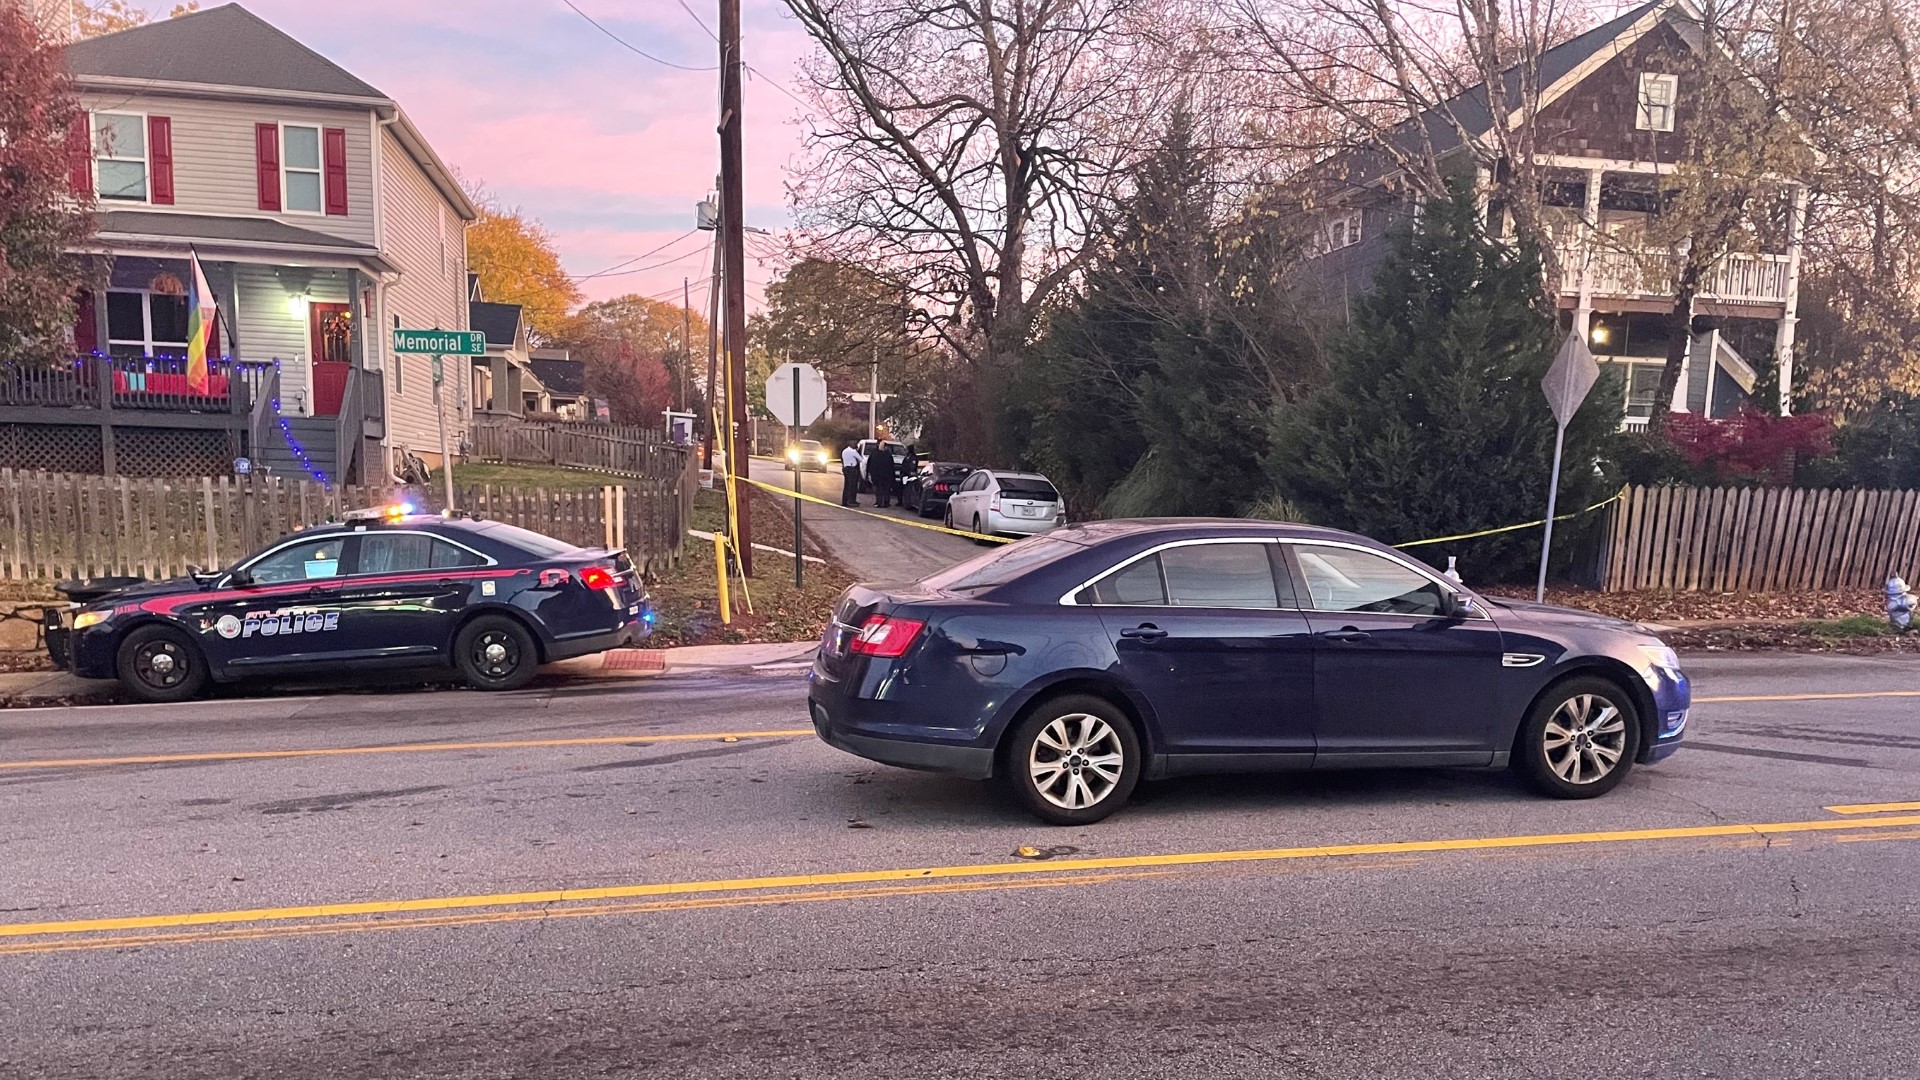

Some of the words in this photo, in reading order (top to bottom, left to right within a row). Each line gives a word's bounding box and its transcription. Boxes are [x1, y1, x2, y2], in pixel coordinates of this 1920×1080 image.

[394, 332, 462, 352] Memorial
[470, 333, 482, 343] DR
[471, 343, 482, 353] SE
[242, 612, 340, 638] POLICE
